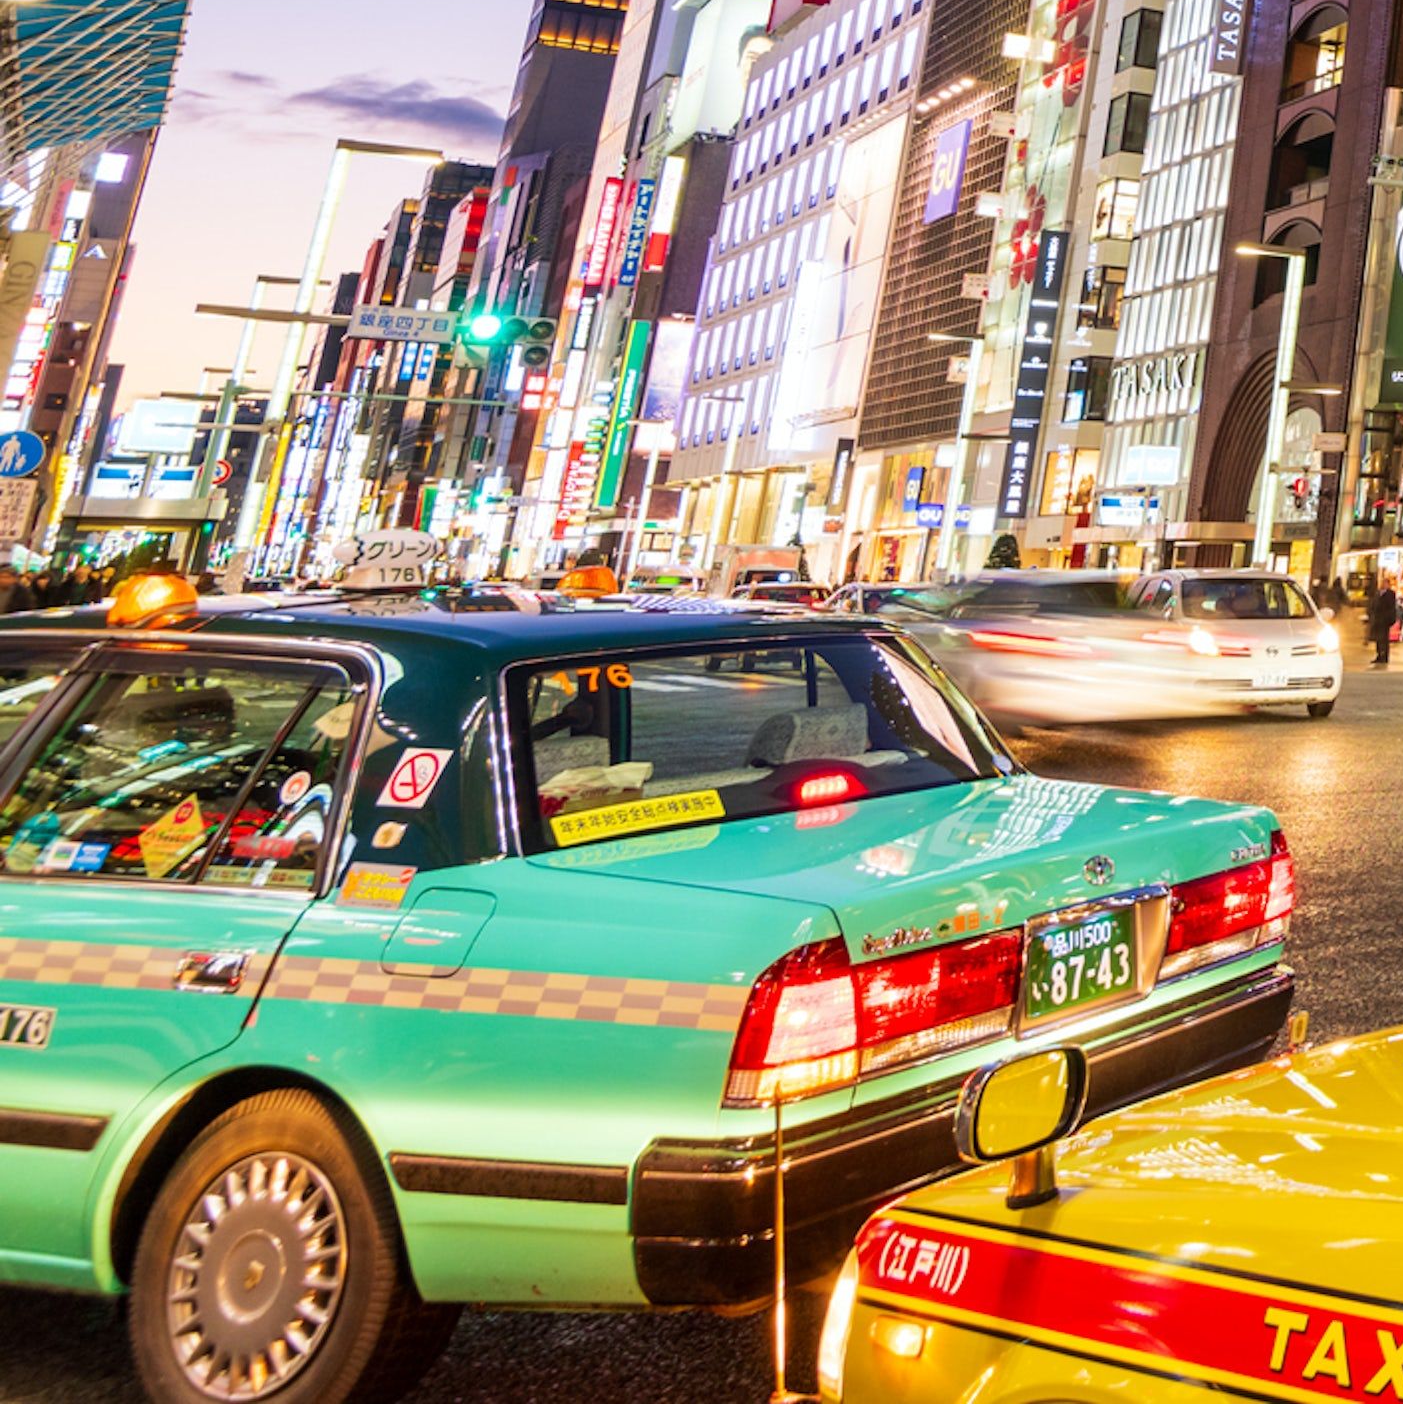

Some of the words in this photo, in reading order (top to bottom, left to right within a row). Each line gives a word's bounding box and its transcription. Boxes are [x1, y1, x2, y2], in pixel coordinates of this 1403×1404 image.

[931, 145, 963, 198] GU
[359, 313, 450, 333] 銀座四丁目
[1111, 352, 1199, 401] TASAKI
[366, 539, 436, 562] グリーン
[378, 566, 417, 584] 176
[553, 662, 635, 695] 176
[1084, 920, 1112, 946] 500
[1050, 943, 1130, 1006] 87-43
